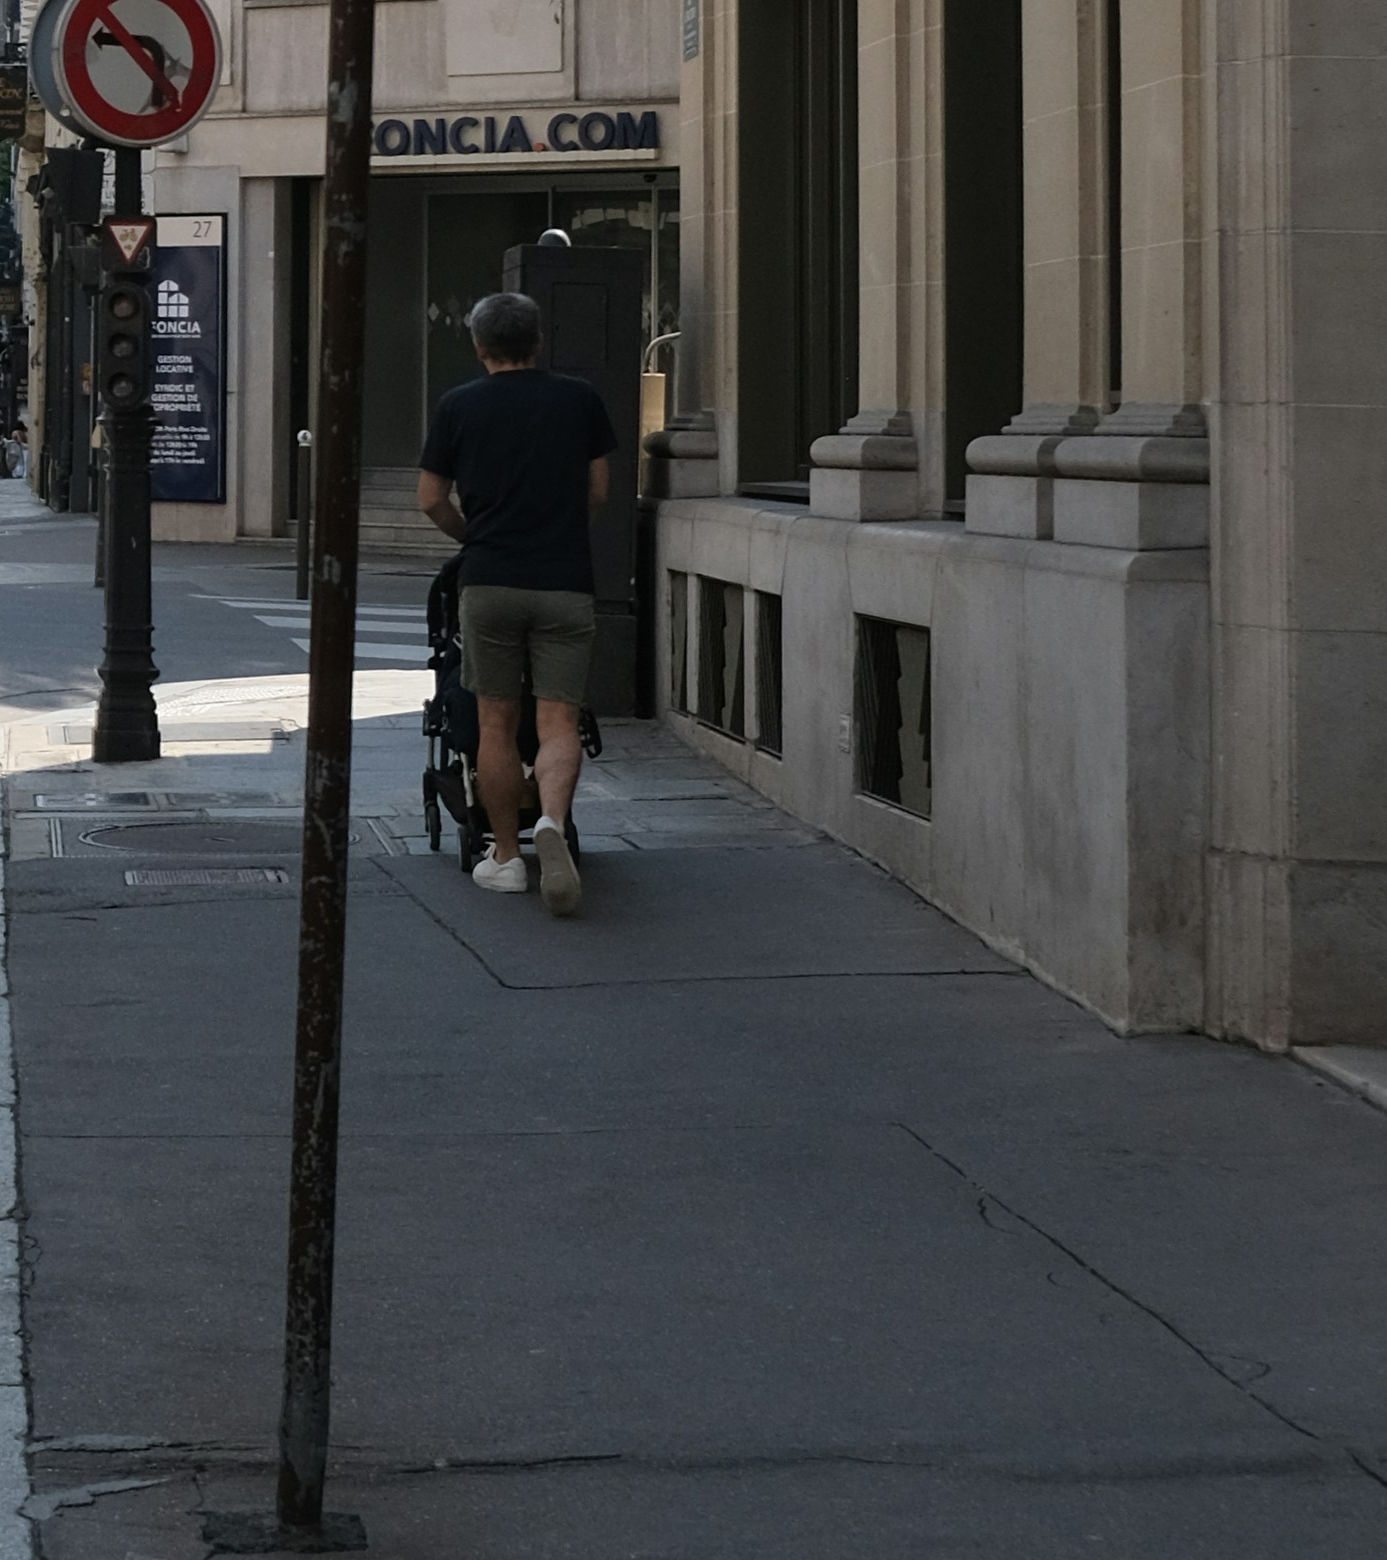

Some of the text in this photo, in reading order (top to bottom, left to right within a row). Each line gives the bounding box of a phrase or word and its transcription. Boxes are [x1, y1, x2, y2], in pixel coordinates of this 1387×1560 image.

[373, 111, 660, 156] ONCIA.COM
[193, 221, 212, 238] 27
[157, 355, 192, 363] GESTION
[156, 365, 194, 373] LOCATIVE
[154, 384, 195, 392] SYNDIC ET
[151, 394, 198, 402] GESTION DE
